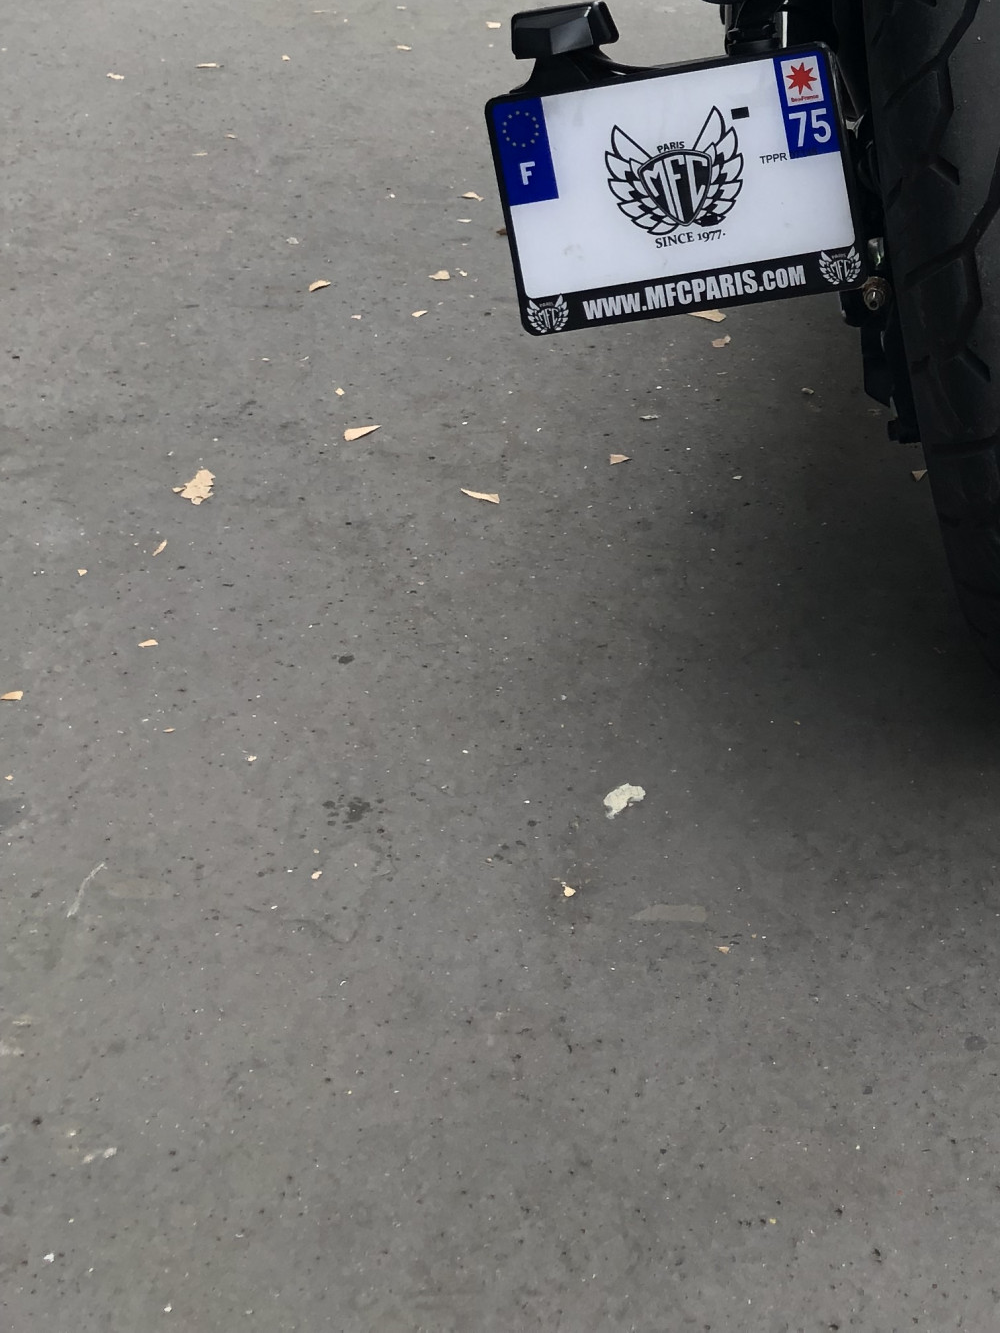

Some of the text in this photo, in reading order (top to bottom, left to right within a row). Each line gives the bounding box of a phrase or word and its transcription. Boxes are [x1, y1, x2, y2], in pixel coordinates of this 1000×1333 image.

[788, 108, 832, 148] 75
[656, 141, 685, 153] PARIS
[759, 152, 788, 165] TPPR
[520, 161, 535, 185] F
[643, 154, 708, 222] MFC
[655, 231, 695, 249] SINCE
[830, 259, 851, 281] MFC
[582, 265, 807, 321] WWW.MFCPARIS.COM
[538, 307, 559, 329] MFC
